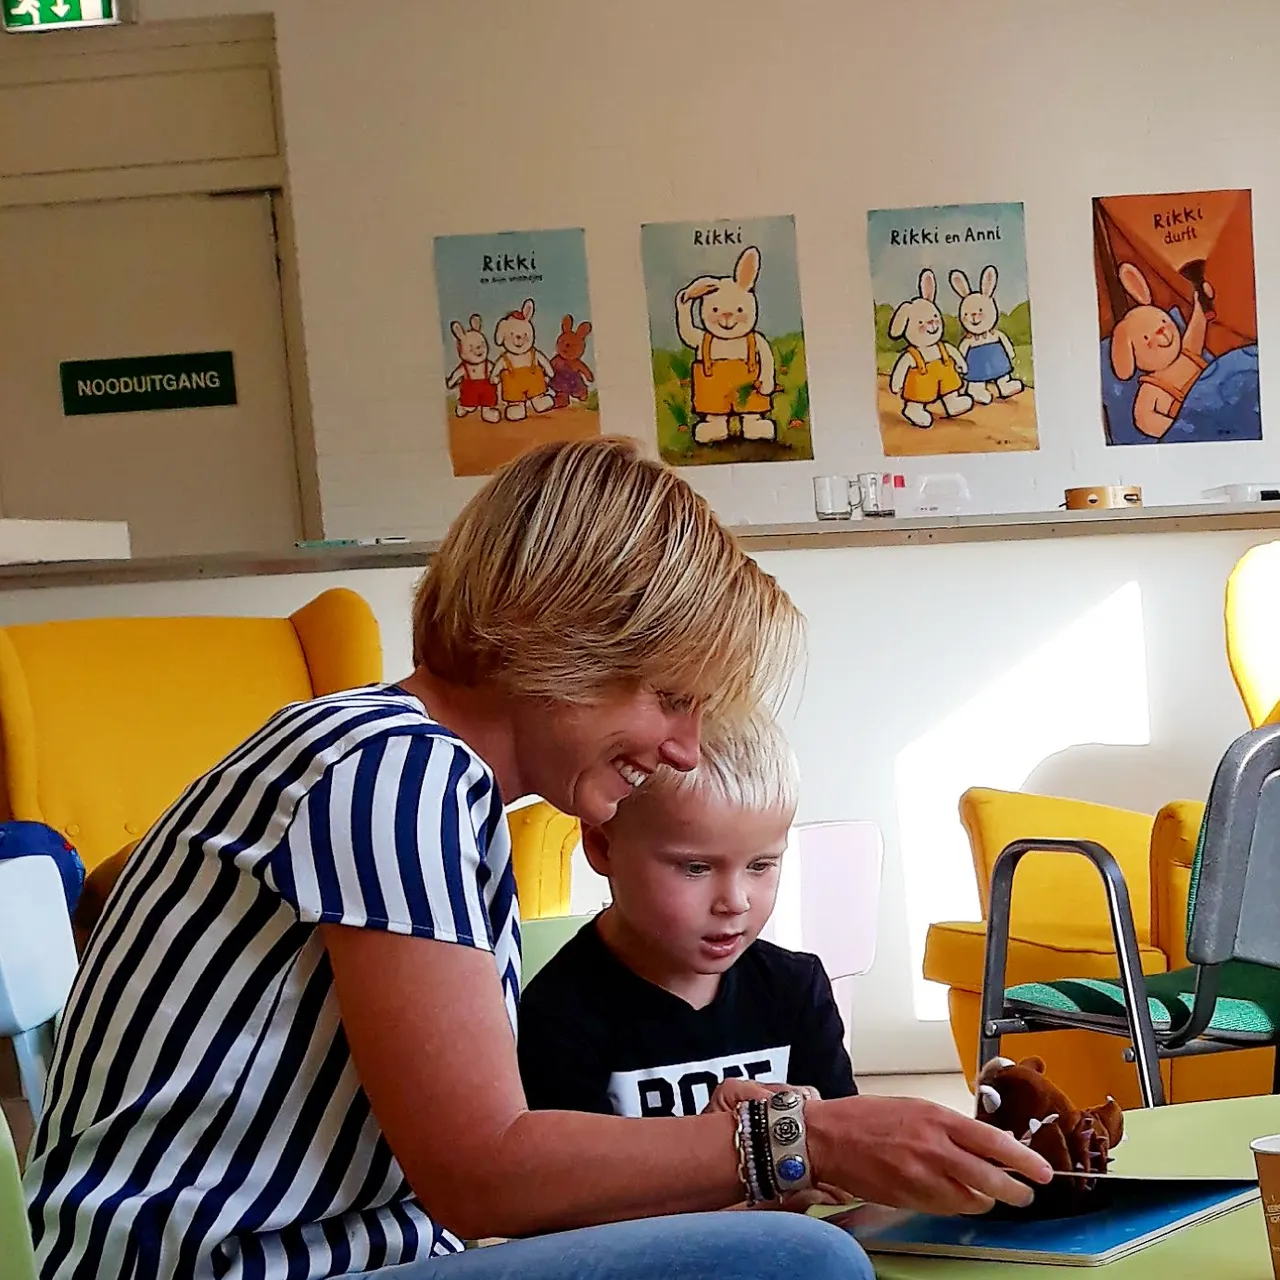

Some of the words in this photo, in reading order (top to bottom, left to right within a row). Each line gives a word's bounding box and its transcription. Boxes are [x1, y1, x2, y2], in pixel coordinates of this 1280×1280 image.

[1153, 203, 1203, 230] Rikki
[693, 227, 743, 246] Rikki
[890, 226, 939, 246] Rikki
[945, 233, 961, 244] en
[964, 225, 1002, 243] Anni
[482, 250, 537, 272] Rikki
[77, 370, 221, 397] NOODUITGANG
